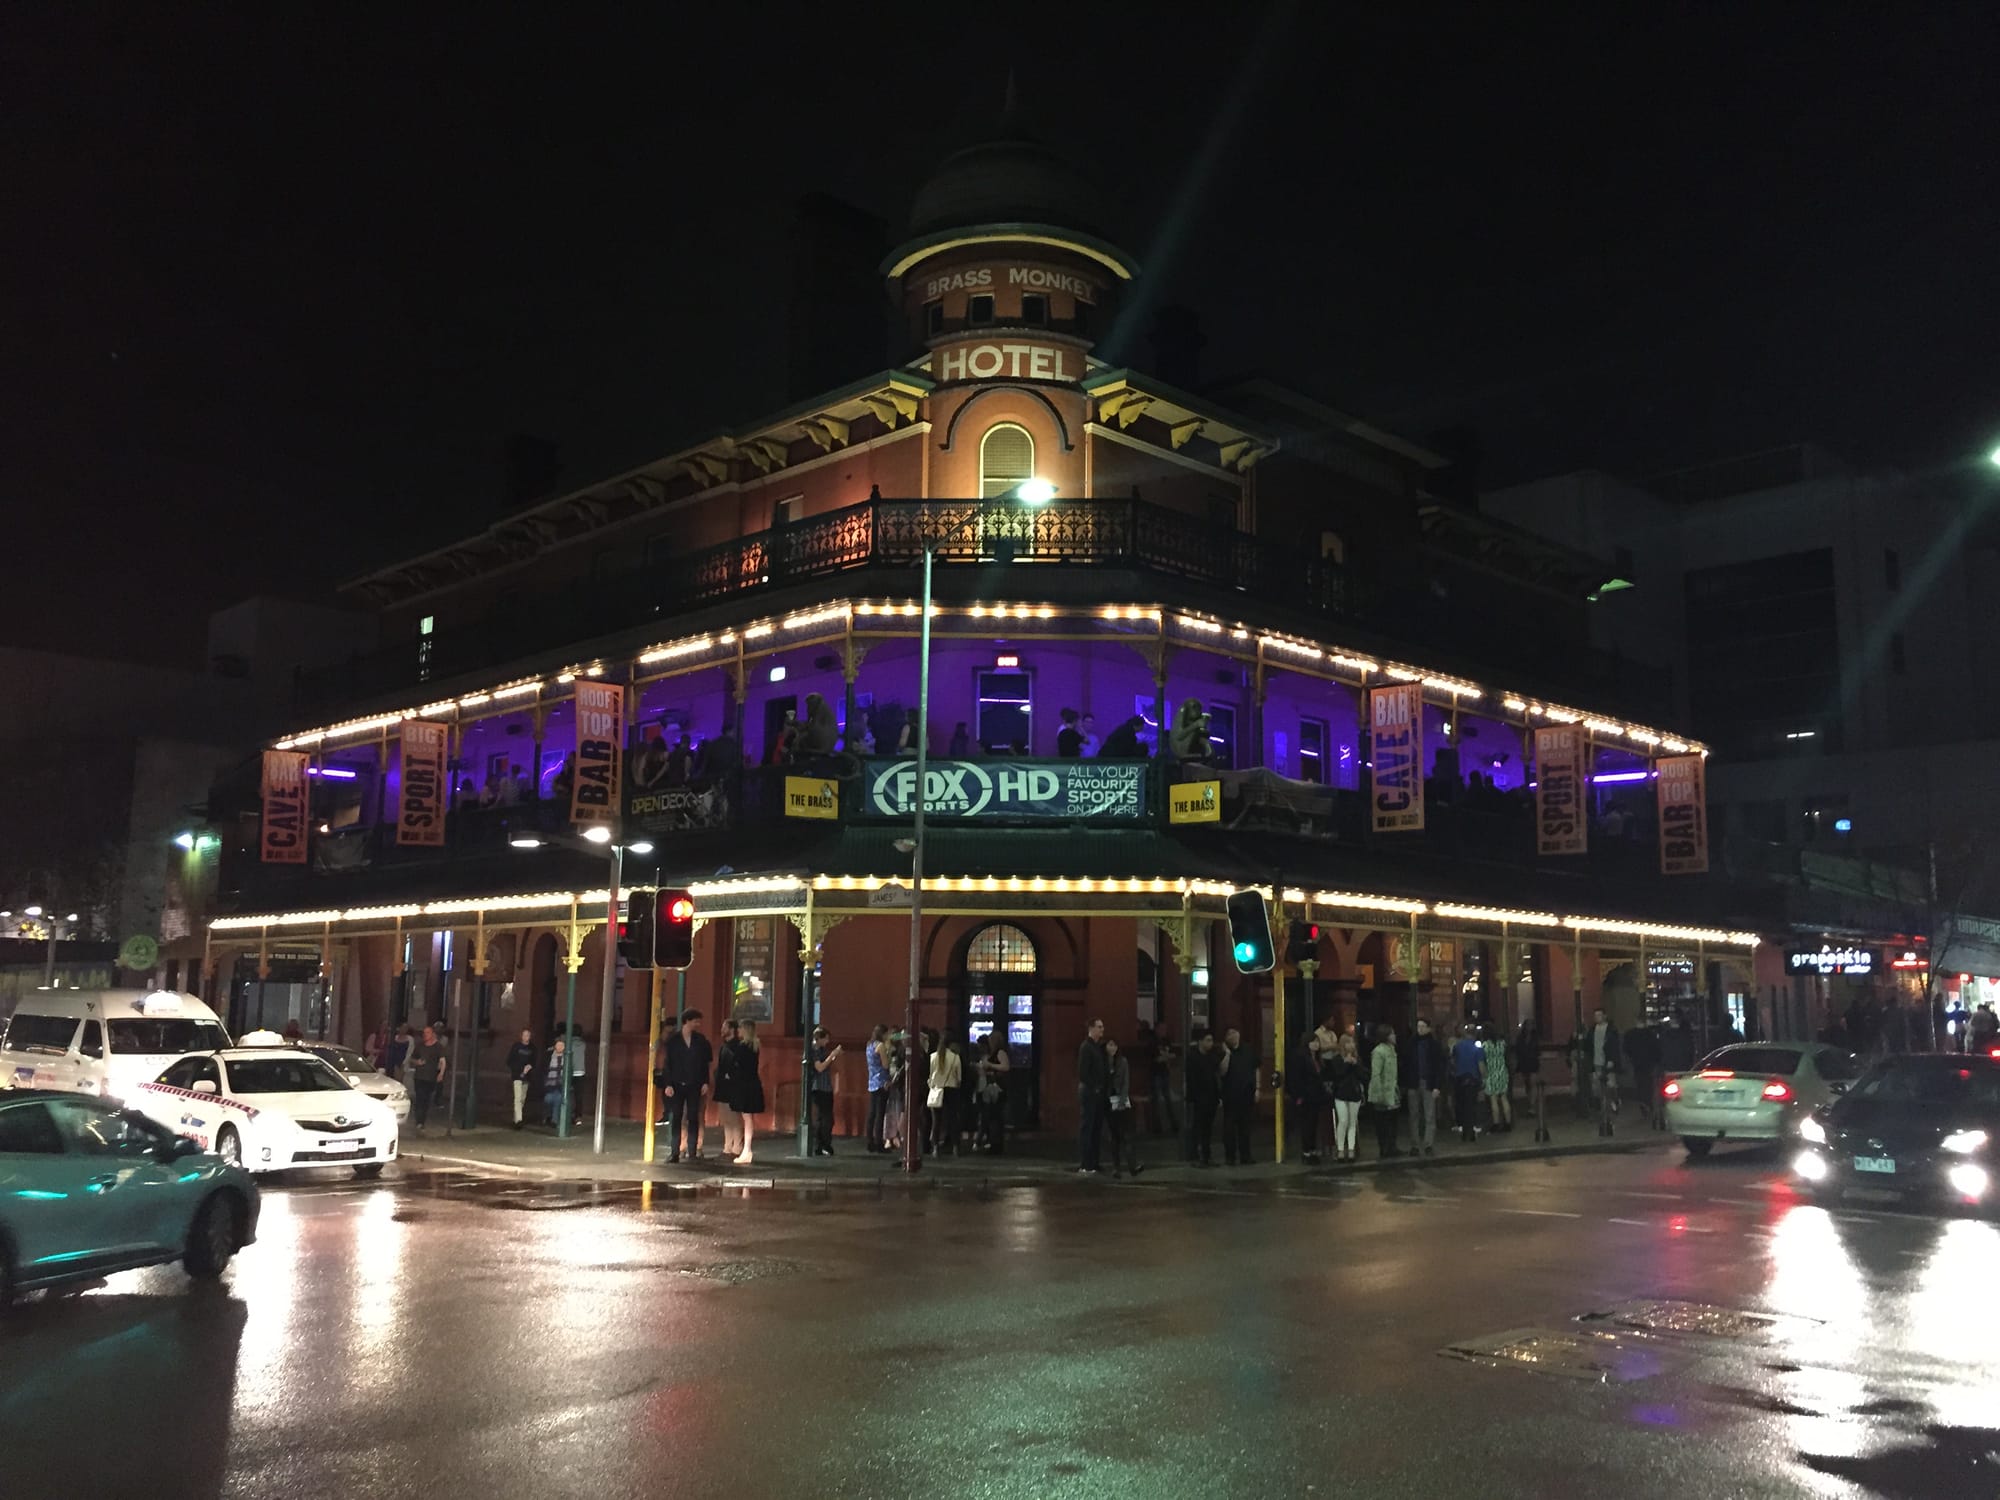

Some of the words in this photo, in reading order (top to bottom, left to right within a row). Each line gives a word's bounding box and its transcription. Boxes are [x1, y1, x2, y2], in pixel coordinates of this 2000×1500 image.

[927, 268, 992, 298] BRASS
[1008, 267, 1093, 298] MONKEY
[942, 344, 1076, 382] HOTEL
[580, 710, 612, 737] TOP
[1375, 691, 1409, 727] BAR
[405, 726, 436, 745] BIG
[1540, 731, 1573, 751] BIG
[577, 739, 612, 806] BAR
[1067, 765, 1095, 778] ALL
[1098, 765, 1139, 779] YOUR
[1067, 778, 1139, 790] FAVOURITE
[1375, 729, 1411, 811] CAVE
[404, 754, 435, 828] SPORT
[897, 769, 969, 802] FOX
[999, 769, 1060, 802] HD
[1067, 789, 1139, 805] SPORTS
[1541, 763, 1574, 836] SPORT
[1662, 781, 1692, 803] TOP
[790, 793, 806, 807] THE
[807, 794, 833, 809] BRASS
[1067, 804, 1086, 815] ON
[1109, 803, 1138, 815] HERE
[1174, 800, 1189, 813] THE
[1190, 799, 1216, 812] BRASS
[266, 786, 299, 848] CAVE
[1663, 803, 1696, 858] BAR
